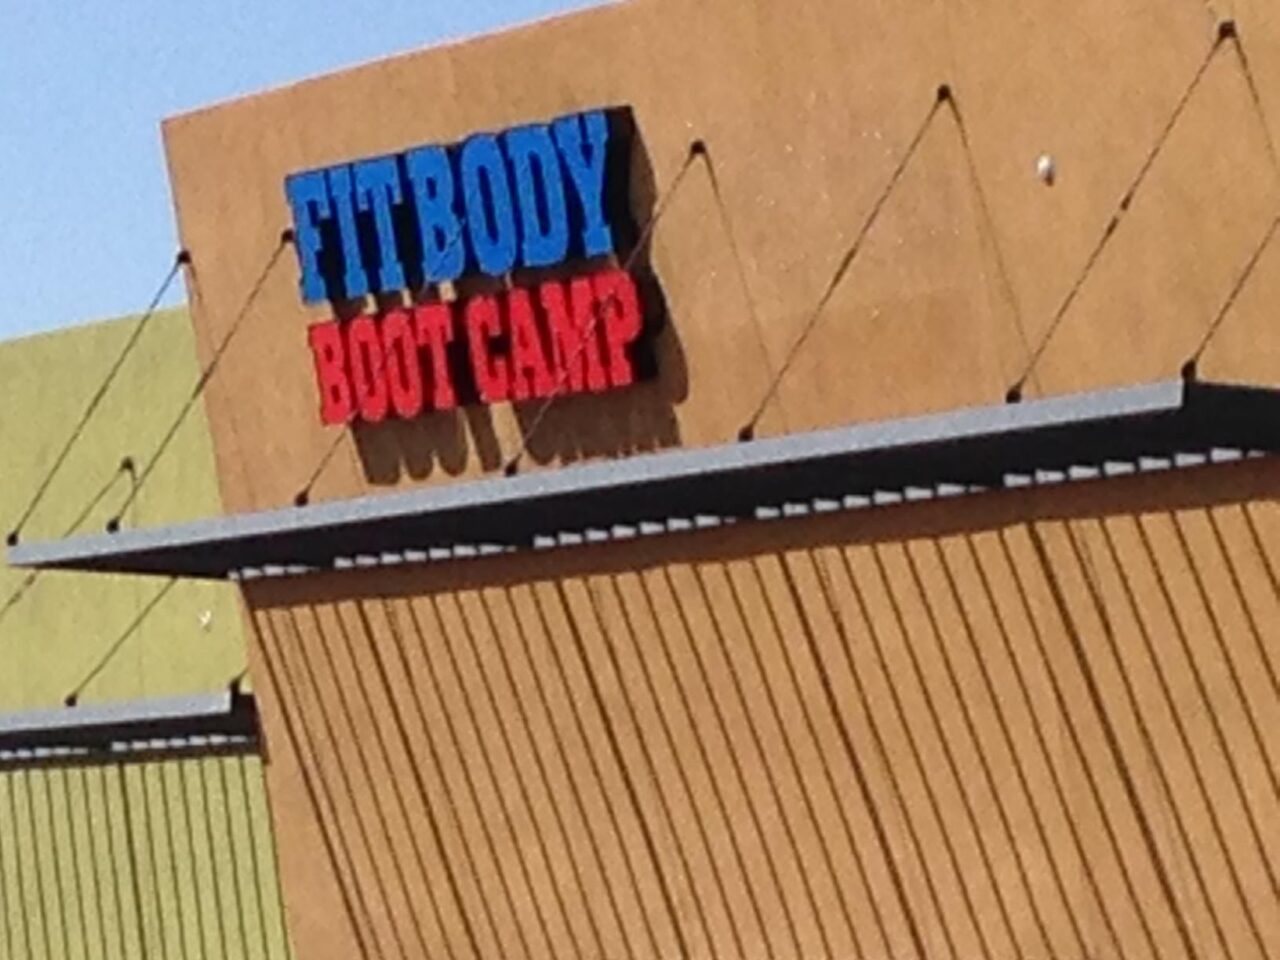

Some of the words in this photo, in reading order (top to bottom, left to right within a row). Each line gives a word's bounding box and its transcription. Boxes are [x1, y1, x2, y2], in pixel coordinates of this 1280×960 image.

[284, 156, 406, 307] FIT
[406, 111, 614, 284] BODY
[308, 304, 458, 426] BOOT
[466, 269, 643, 404] CAMP
